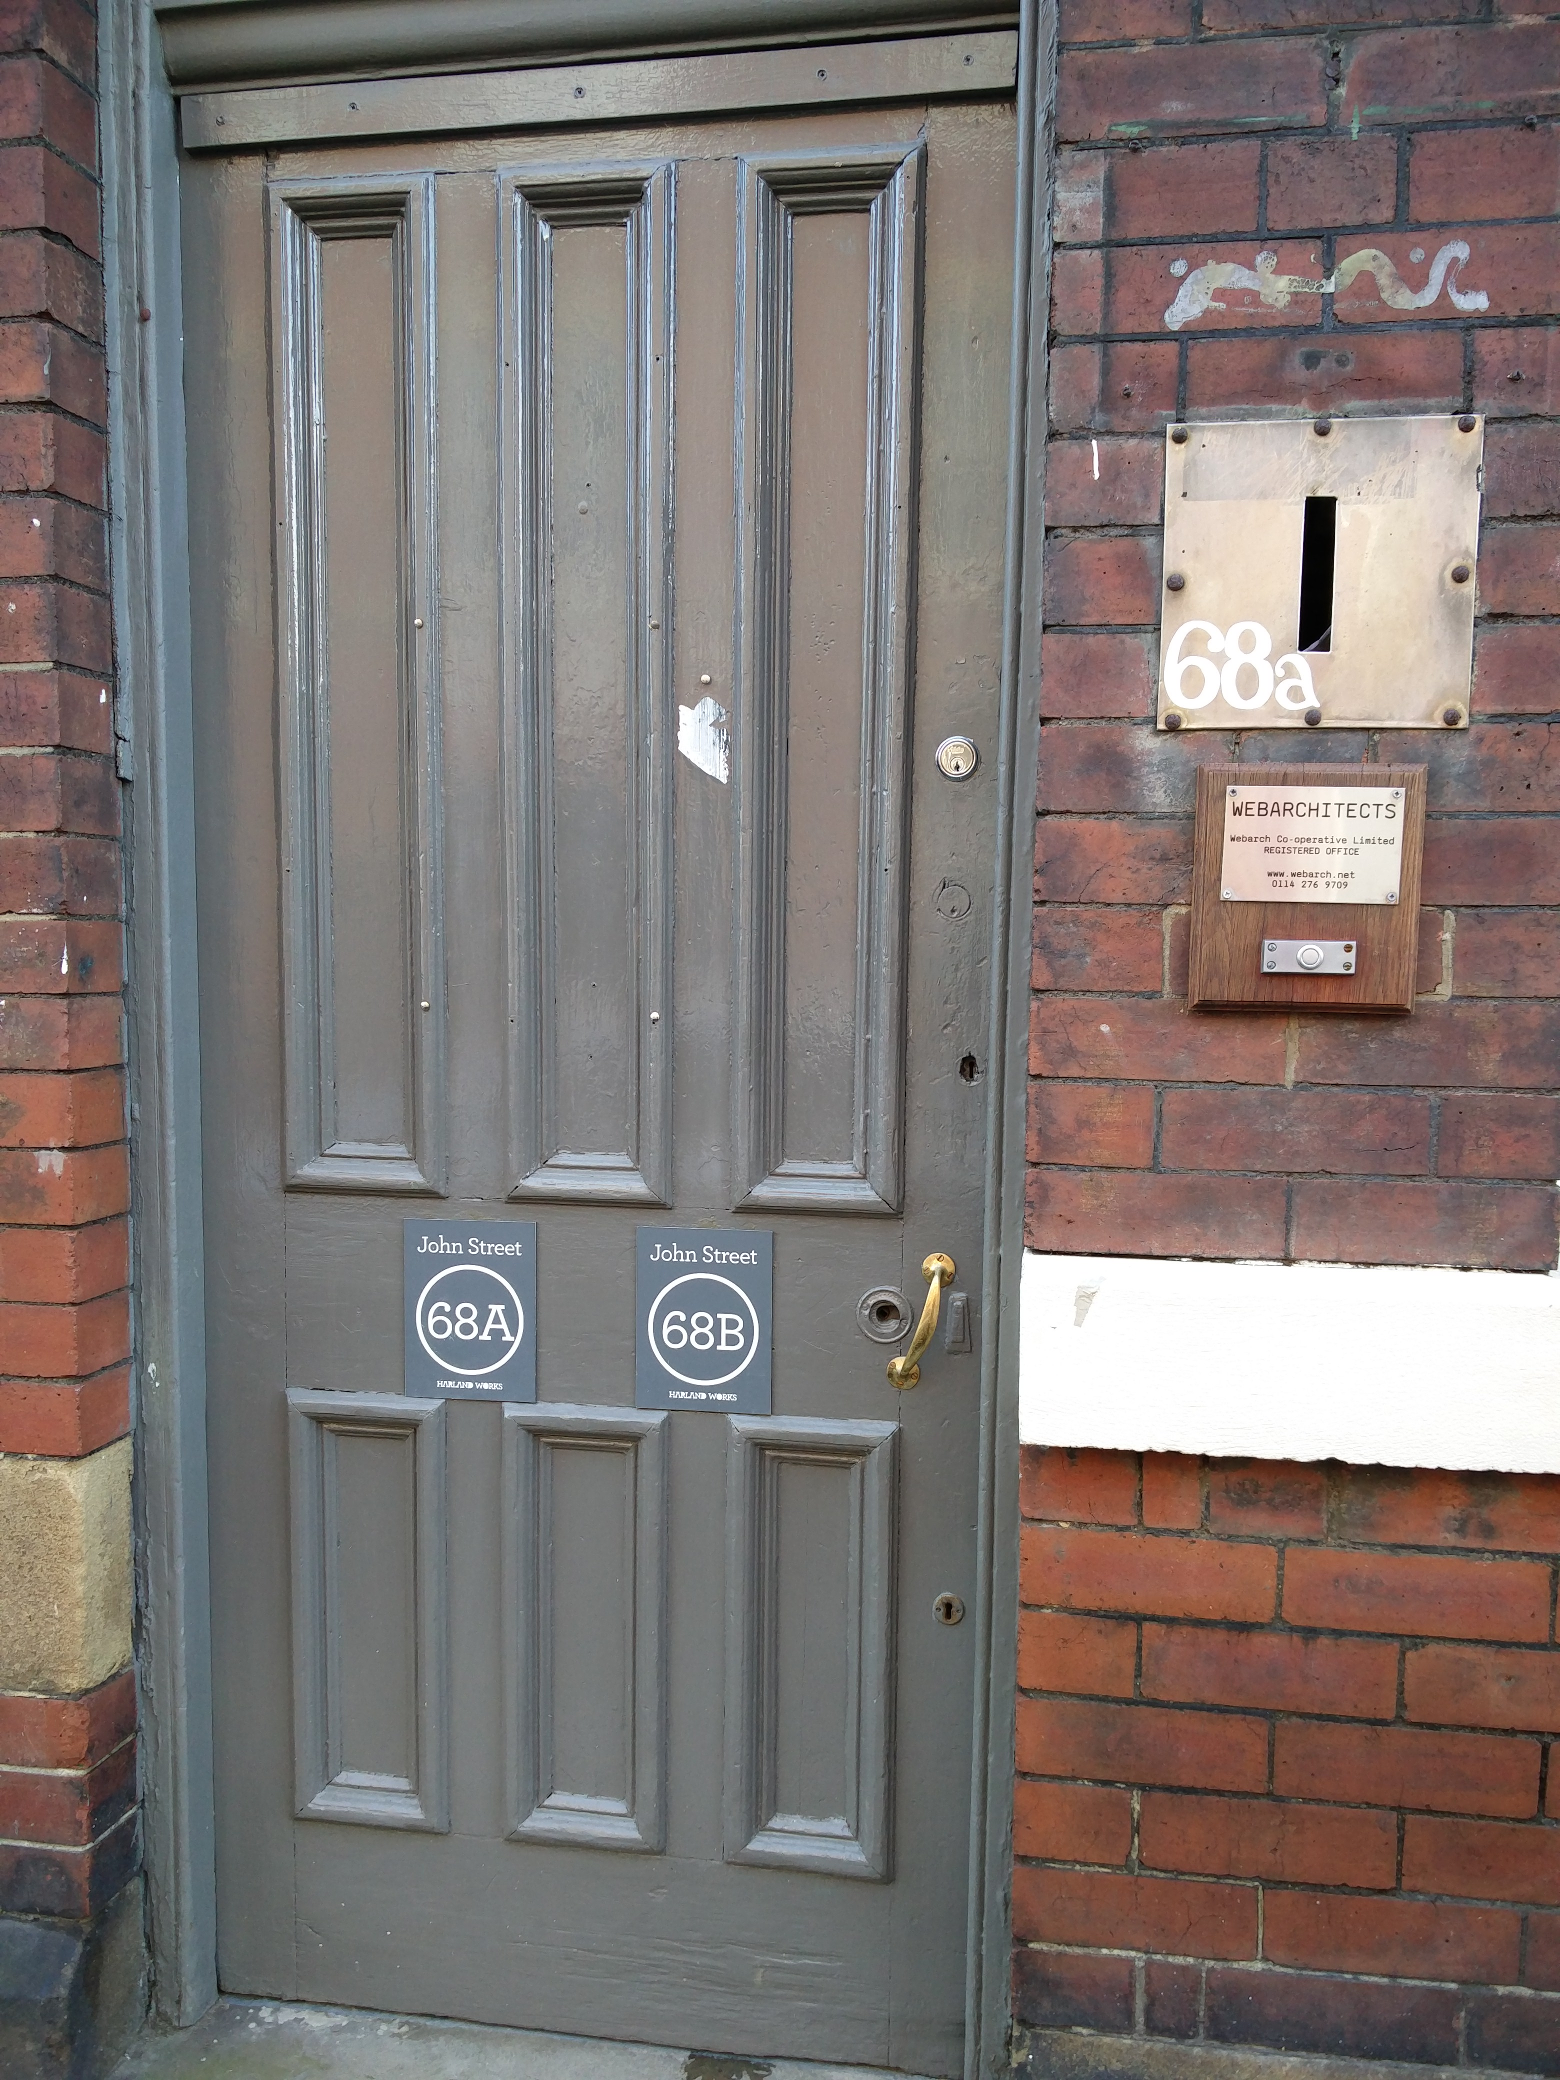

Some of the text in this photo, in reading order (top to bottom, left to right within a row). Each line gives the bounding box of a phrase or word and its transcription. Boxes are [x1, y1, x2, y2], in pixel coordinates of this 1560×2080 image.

[1163, 620, 1321, 711] 68a
[1231, 801, 1397, 820] WEBARCHITECTS
[1229, 834, 1395, 845] Webarch Co-operative Limited
[1263, 846, 1360, 856] REGISTERED OFFICE
[1266, 870, 1356, 879] www.webarch.net
[1271, 880, 1349, 889] 0114 276 9709
[416, 1234, 523, 1257] John Street
[649, 1243, 758, 1265] John Street
[427, 1301, 515, 1342] 68A
[661, 1310, 746, 1351] 68B
[436, 1380, 503, 1391] HARLAND WORKS
[668, 1390, 738, 1402] HARLAND WORKS
